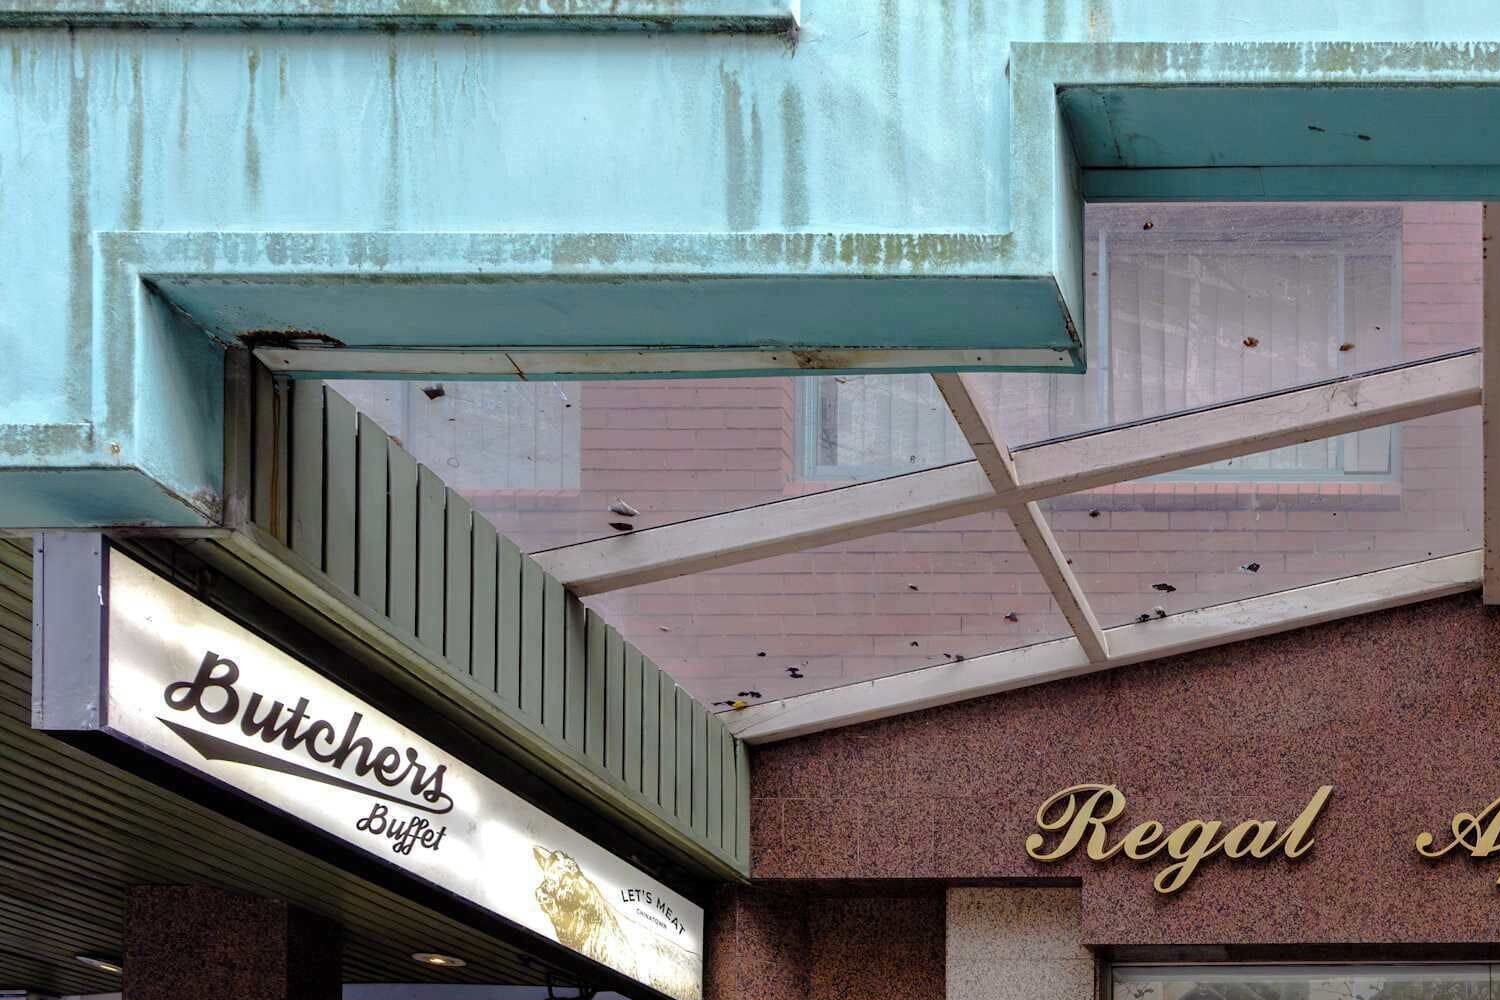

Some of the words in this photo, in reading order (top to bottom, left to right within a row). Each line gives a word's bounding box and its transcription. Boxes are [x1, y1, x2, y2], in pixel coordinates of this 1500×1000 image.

[164, 651, 449, 803] Butchers
[356, 803, 447, 855] Buffet
[1025, 783, 1335, 894] Regal
[621, 888, 652, 904] LET'S
[656, 898, 686, 935] MEAT
